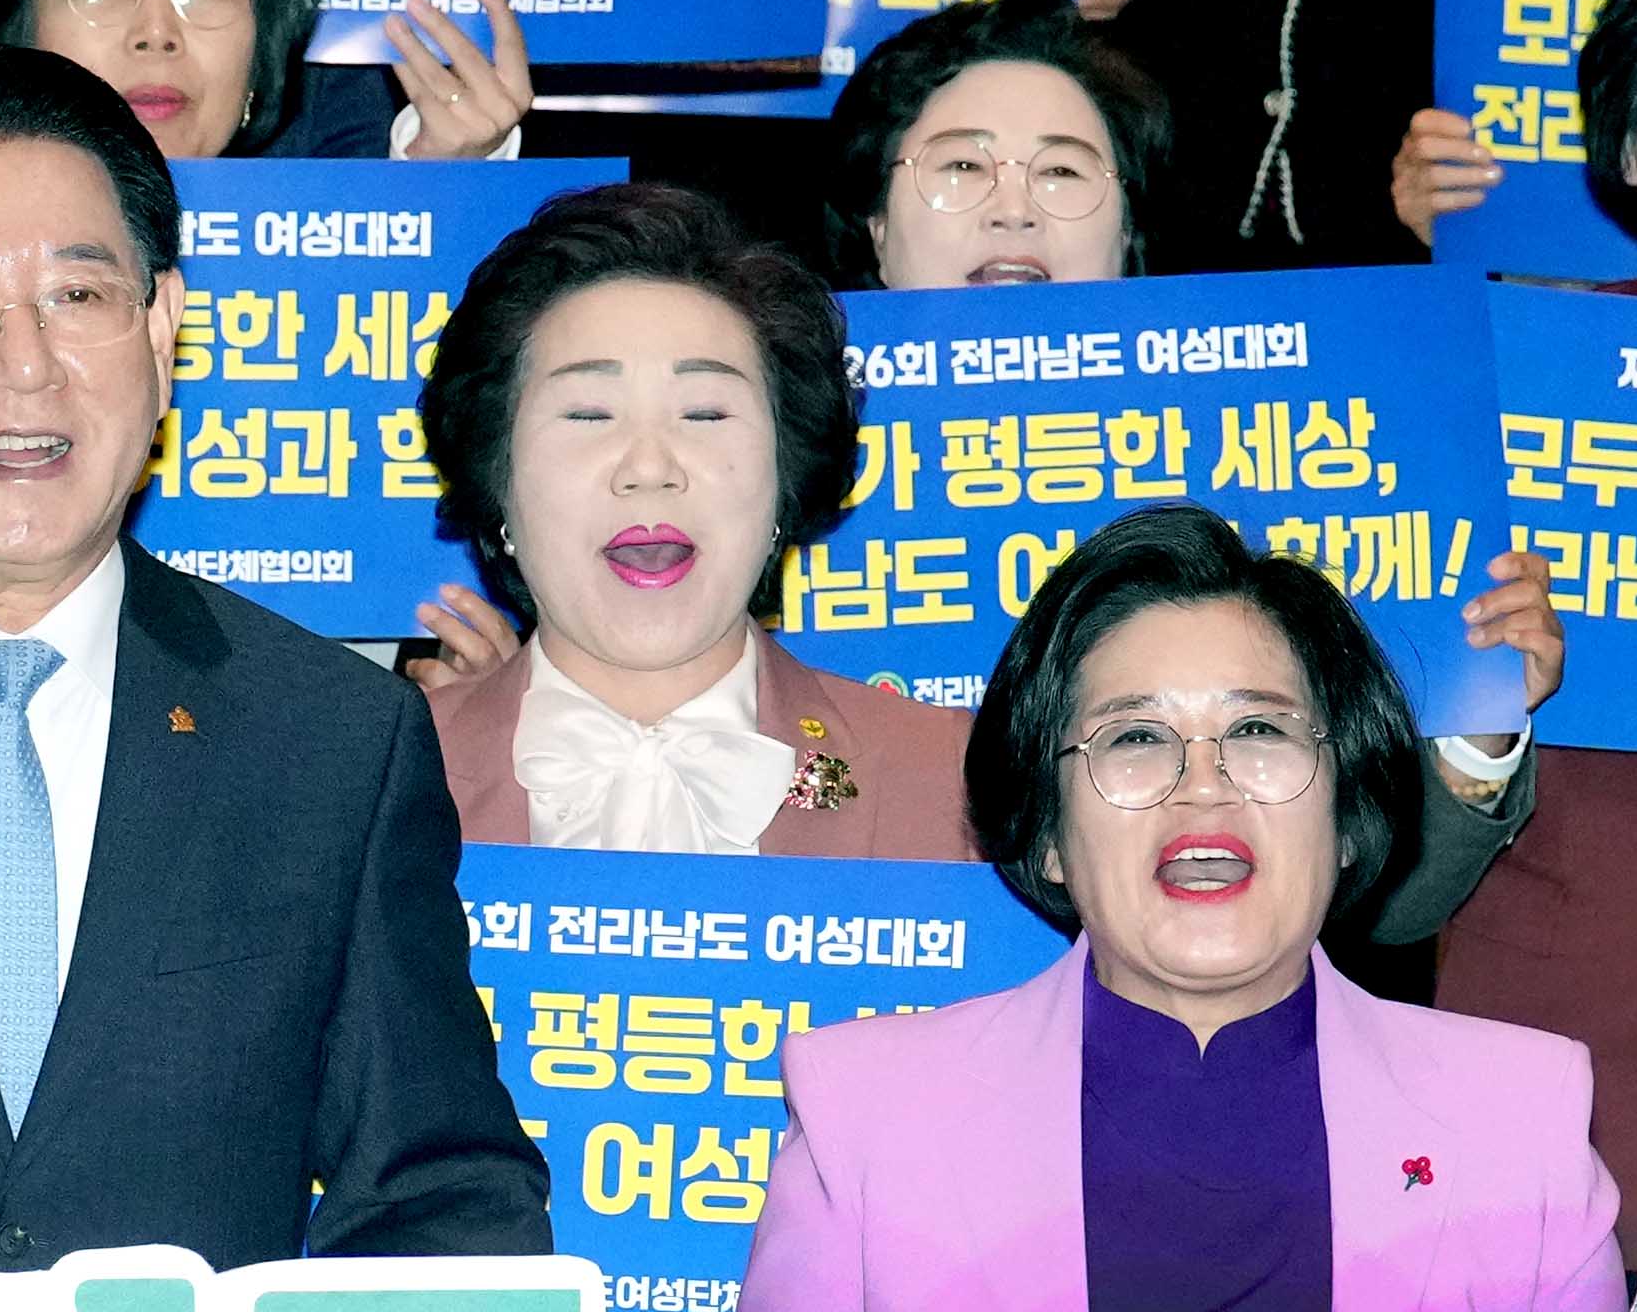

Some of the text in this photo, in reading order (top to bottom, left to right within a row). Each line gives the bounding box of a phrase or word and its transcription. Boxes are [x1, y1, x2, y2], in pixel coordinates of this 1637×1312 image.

[254, 211, 432, 258] 여성대회
[950, 321, 1309, 385] 전라남도 여성대회
[940, 397, 1397, 508] 평등한 세상,
[547, 905, 966, 969] 전라남도 여성대회
